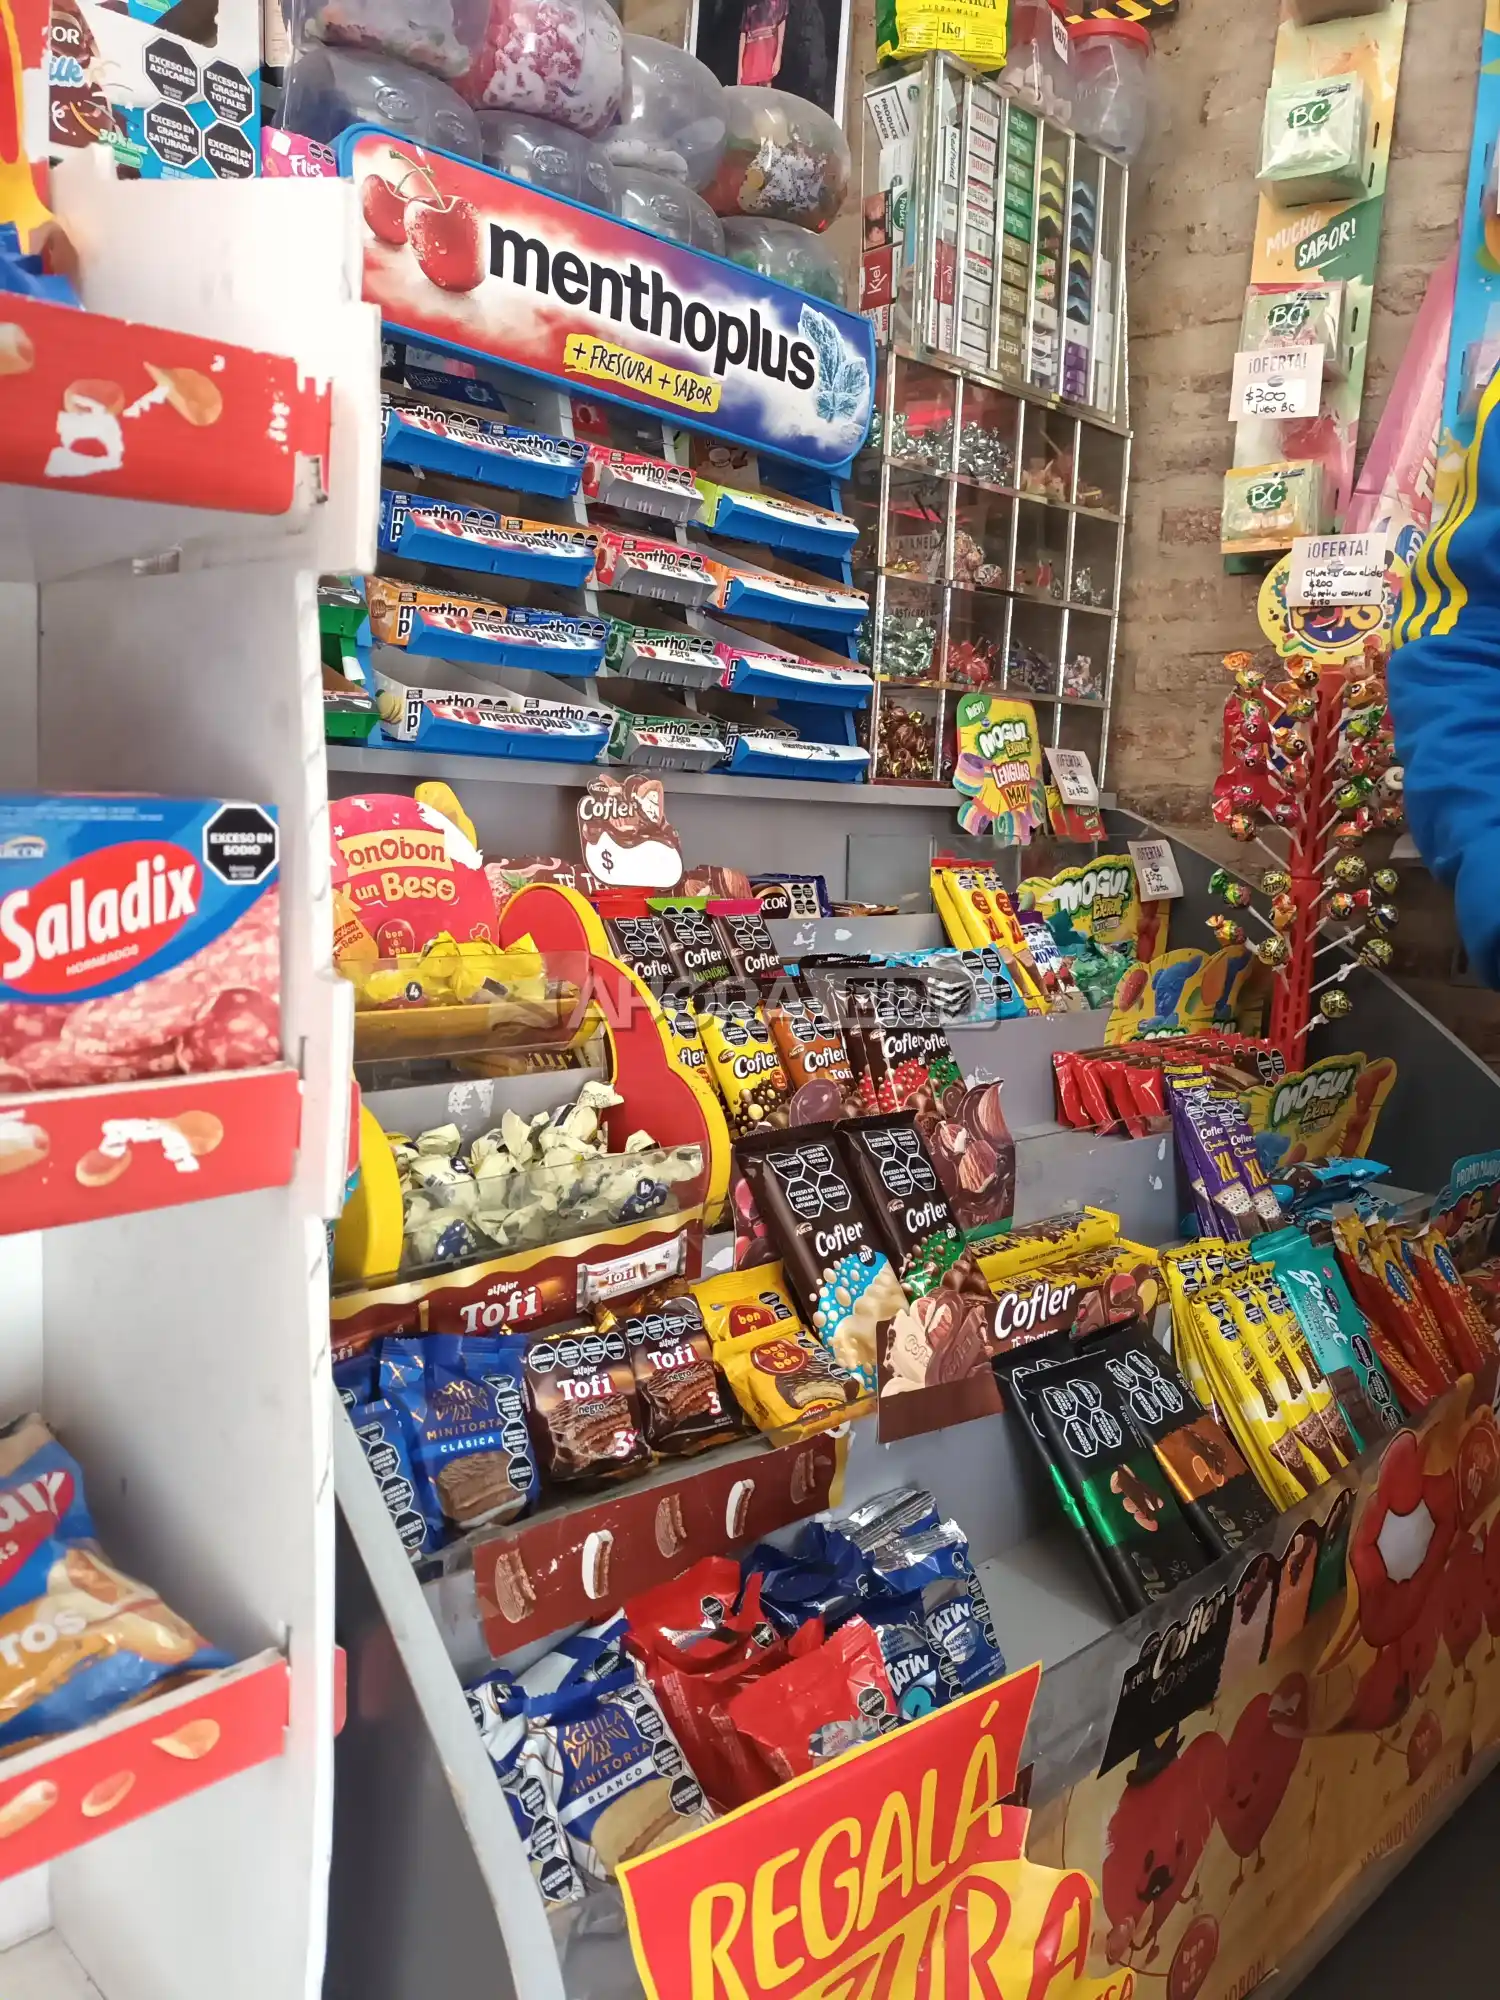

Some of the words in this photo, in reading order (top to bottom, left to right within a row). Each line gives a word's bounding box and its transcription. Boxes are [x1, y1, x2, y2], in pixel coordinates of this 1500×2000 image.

[942, 21, 961, 37] 1Kg
[149, 54, 183, 74] EXCESO
[184, 64, 196, 77] EN
[150, 65, 196, 88] AZÚCARES
[206, 71, 238, 89] EXCESO
[239, 82, 250, 94] EN
[212, 82, 245, 102] GRASAS
[210, 92, 247, 112] TOTALES
[151, 114, 183, 133] EXCESO
[183, 123, 195, 134] EN
[880, 98, 898, 140] PRODUCE
[1290, 103, 1326, 128] BC
[149, 132, 198, 156] SATURADAS
[157, 124, 190, 143] GRASAS
[974, 135, 992, 152] BOXER
[208, 138, 239, 157] EXCESO
[239, 149, 252, 160] EN
[210, 148, 250, 168] CALORÍAS
[972, 158, 990, 172] BOXER
[1266, 211, 1321, 256] MUCHO
[1298, 217, 1356, 266] SABOR!
[967, 260, 987, 276] GOLDEN
[868, 265, 887, 295] Kiel
[489, 222, 816, 389] menthoplus
[1271, 304, 1304, 326] BC
[1249, 352, 1307, 374] ¡OFERTA!
[590, 346, 653, 385] FRESCURA
[672, 378, 714, 407] SABOR
[1245, 386, 1286, 405] $300
[1281, 402, 1296, 413] BC
[446, 425, 543, 458] menthoplus
[610, 462, 665, 480] mentho
[1250, 483, 1283, 507] BC
[461, 522, 556, 550] menthoplus
[623, 550, 676, 567] mentho
[1308, 540, 1369, 558] ¡OFERTA!
[472, 620, 567, 643] menthoplus
[633, 636, 687, 650] mentho
[479, 709, 572, 729] menthoplus
[525, 704, 584, 720] mentho
[965, 701, 985, 720] NUEVO
[979, 722, 1030, 758] MOGUL
[993, 763, 1030, 786] LENGUAS
[579, 795, 638, 820] Cofler
[1006, 785, 1027, 807] MAX
[210, 832, 255, 845] EXCESO
[256, 832, 273, 845] EN
[223, 844, 260, 856] SODIO
[601, 849, 614, 875] $
[356, 884, 380, 901] un
[381, 872, 456, 902] Beso
[1058, 868, 1129, 912] MOGUL
[1, 854, 196, 980] Saladix
[983, 916, 1004, 941] XL
[384, 928, 403, 940] bon
[1007, 918, 1025, 944] XL
[66, 944, 139, 977] HORNEADOS
[685, 948, 722, 968] Cofler
[745, 953, 780, 973] Cofler
[884, 1031, 924, 1057] Cofler
[734, 1050, 779, 1079] Cofler
[804, 1047, 847, 1072] Cofler
[1274, 1069, 1354, 1124] MOGUL
[1200, 1126, 1223, 1139] Cofler
[1231, 1134, 1253, 1146] Cofler
[1214, 1151, 1240, 1183] XL
[1244, 1158, 1269, 1188] XL
[789, 1189, 806, 1197] EXCESO
[905, 1201, 947, 1234] Cofler
[814, 1219, 865, 1257] Cofler
[946, 1223, 958, 1239] air
[859, 1244, 873, 1263] air
[605, 1266, 637, 1286] Tofi
[1436, 1248, 1459, 1285] ARCOR
[487, 1280, 519, 1298] alfajor
[1387, 1264, 1412, 1301] ARCOR
[460, 1287, 539, 1334] Tofi
[738, 1311, 760, 1324] bon
[994, 1283, 1076, 1339] Cofler
[1287, 1269, 1348, 1347] Godet
[658, 1336, 680, 1348] alfajor
[761, 1343, 786, 1354] bon
[648, 1343, 695, 1370] Tofi
[774, 1356, 800, 1368] bon
[573, 1365, 598, 1376] alfajor
[668, 1370, 692, 1382] negro
[557, 1373, 613, 1400] Tofi
[578, 1402, 605, 1415] negro
[426, 1418, 504, 1441] MINITORTA
[440, 1435, 495, 1454] CLÁSICA
[1152, 1592, 1225, 1680] Cofler
[572, 1742, 650, 1794] MINITORTA
[588, 1766, 643, 1805] BLANCO
[689, 1698, 1002, 2000] REGALÁ
